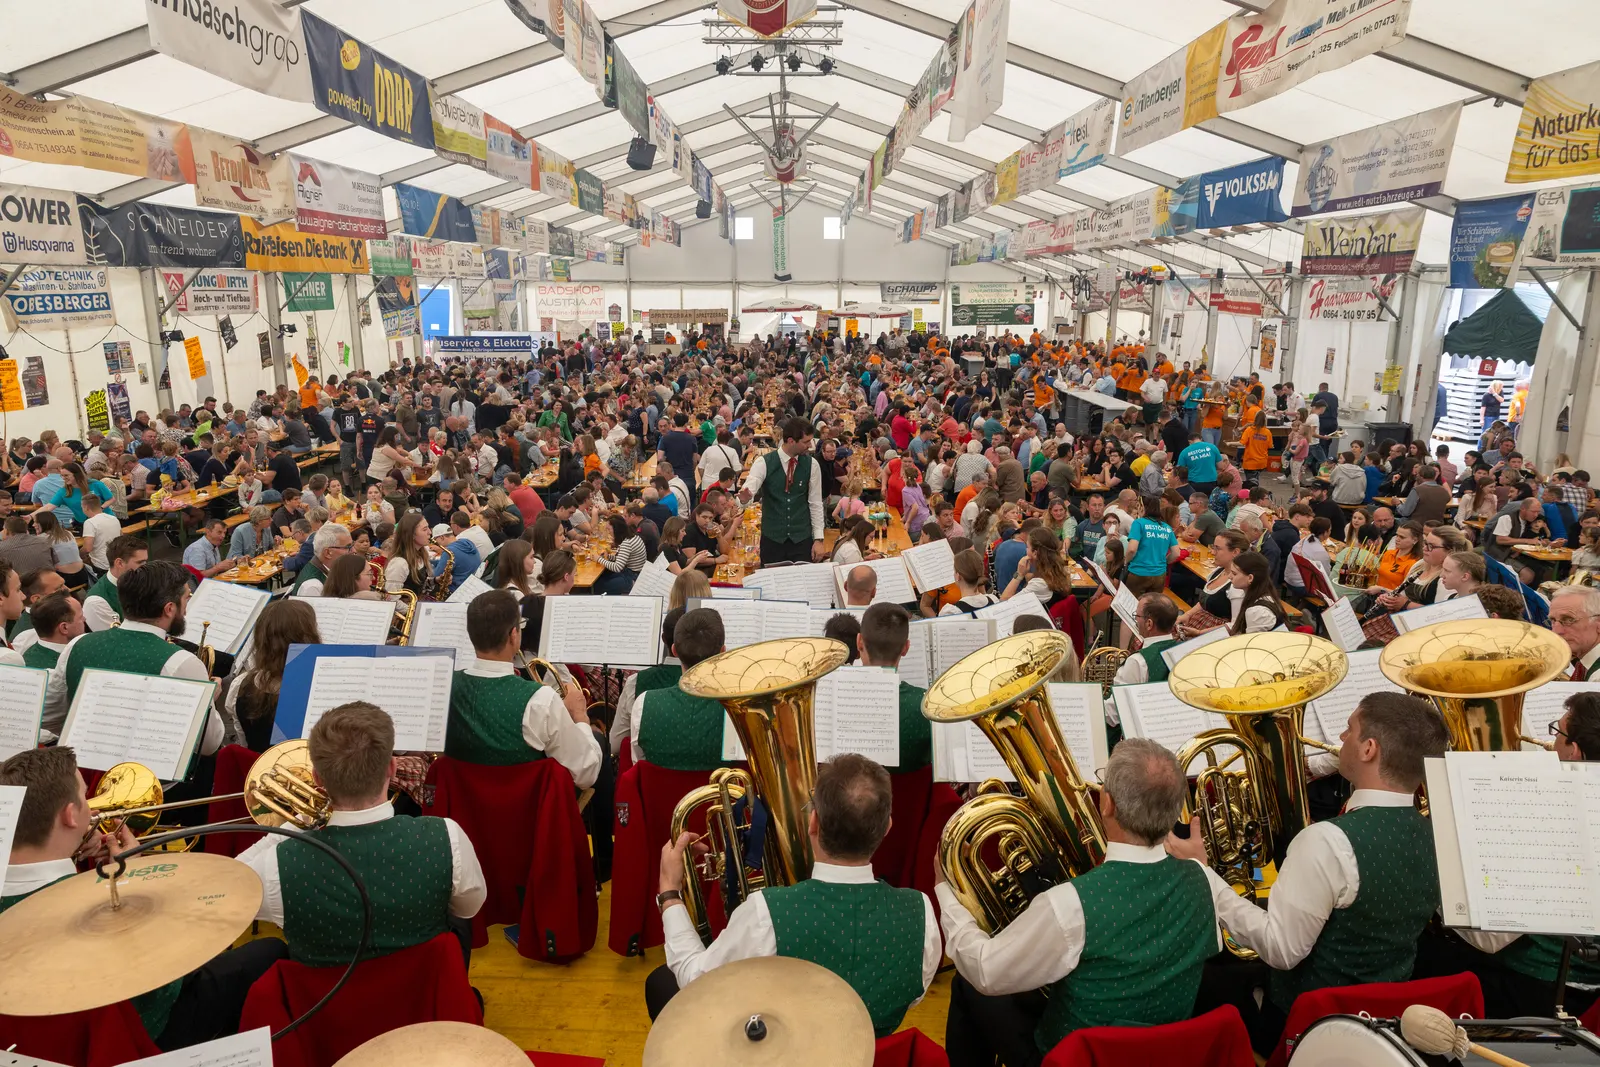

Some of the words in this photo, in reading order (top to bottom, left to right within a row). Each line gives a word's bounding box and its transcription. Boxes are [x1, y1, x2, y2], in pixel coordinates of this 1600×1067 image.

[328, 88, 361, 113] powered
[363, 97, 372, 121] by
[1525, 144, 1555, 169] für
[1558, 139, 1590, 165] das
[297, 184, 323, 204] Aigner
[1538, 189, 1566, 206] GEA
[0, 195, 72, 226] OWER
[127, 211, 229, 238] SCHNEIDER
[18, 236, 75, 254] Husqvarna
[159, 241, 185, 256] trend
[186, 242, 217, 257] wohnen
[305, 238, 323, 257] Die
[323, 239, 348, 260] Bank
[1307, 241, 1321, 256] Die
[1320, 225, 1396, 258] Weinbar
[68, 281, 97, 291] Stahlbau
[192, 274, 249, 289] JUNGWIRTH
[291, 281, 327, 297] LEHNER
[887, 285, 938, 293] SCHAUPP
[194, 294, 213, 303] Hoch-
[214, 294, 226, 303] und
[227, 293, 251, 303] Tiefbau
[538, 285, 603, 296] BADSHOP-
[13, 295, 108, 313] OBESBERGER
[538, 297, 603, 307] AUSTRIA.AT
[1323, 309, 1338, 319] 0664
[1343, 309, 1355, 319] 210
[1356, 309, 1366, 319] 97
[1366, 309, 1377, 319] 95
[439, 338, 480, 348] uservice
[483, 338, 491, 347] &
[493, 338, 531, 347] Elektro
[1146, 531, 1156, 539] BA
[142, 873, 175, 882] 1000
